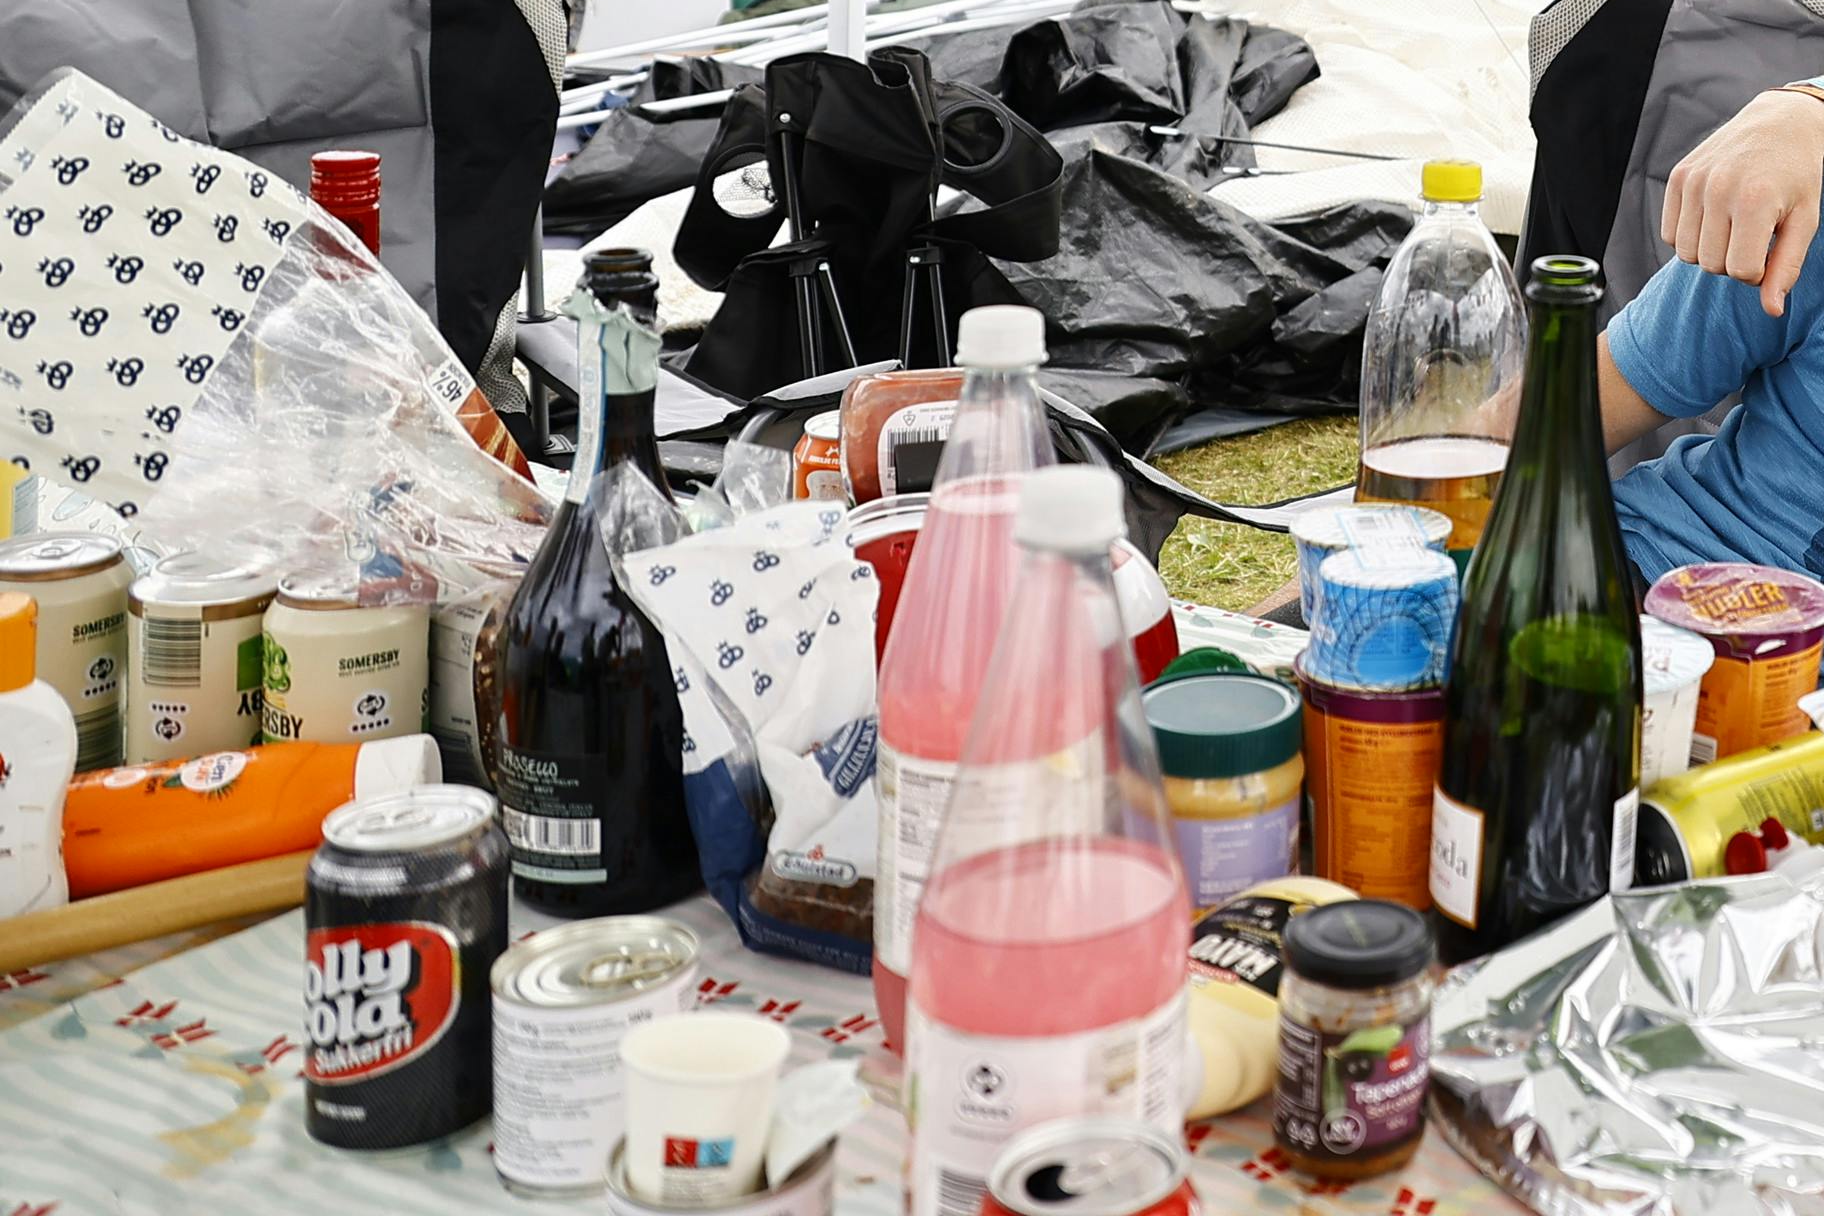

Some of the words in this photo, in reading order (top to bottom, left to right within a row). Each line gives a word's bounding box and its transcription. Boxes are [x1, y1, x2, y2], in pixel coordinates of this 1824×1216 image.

[432, 370, 462, 402] 46%
[72, 612, 125, 638] SOMERSBY
[338, 648, 401, 672] SOMERSBY
